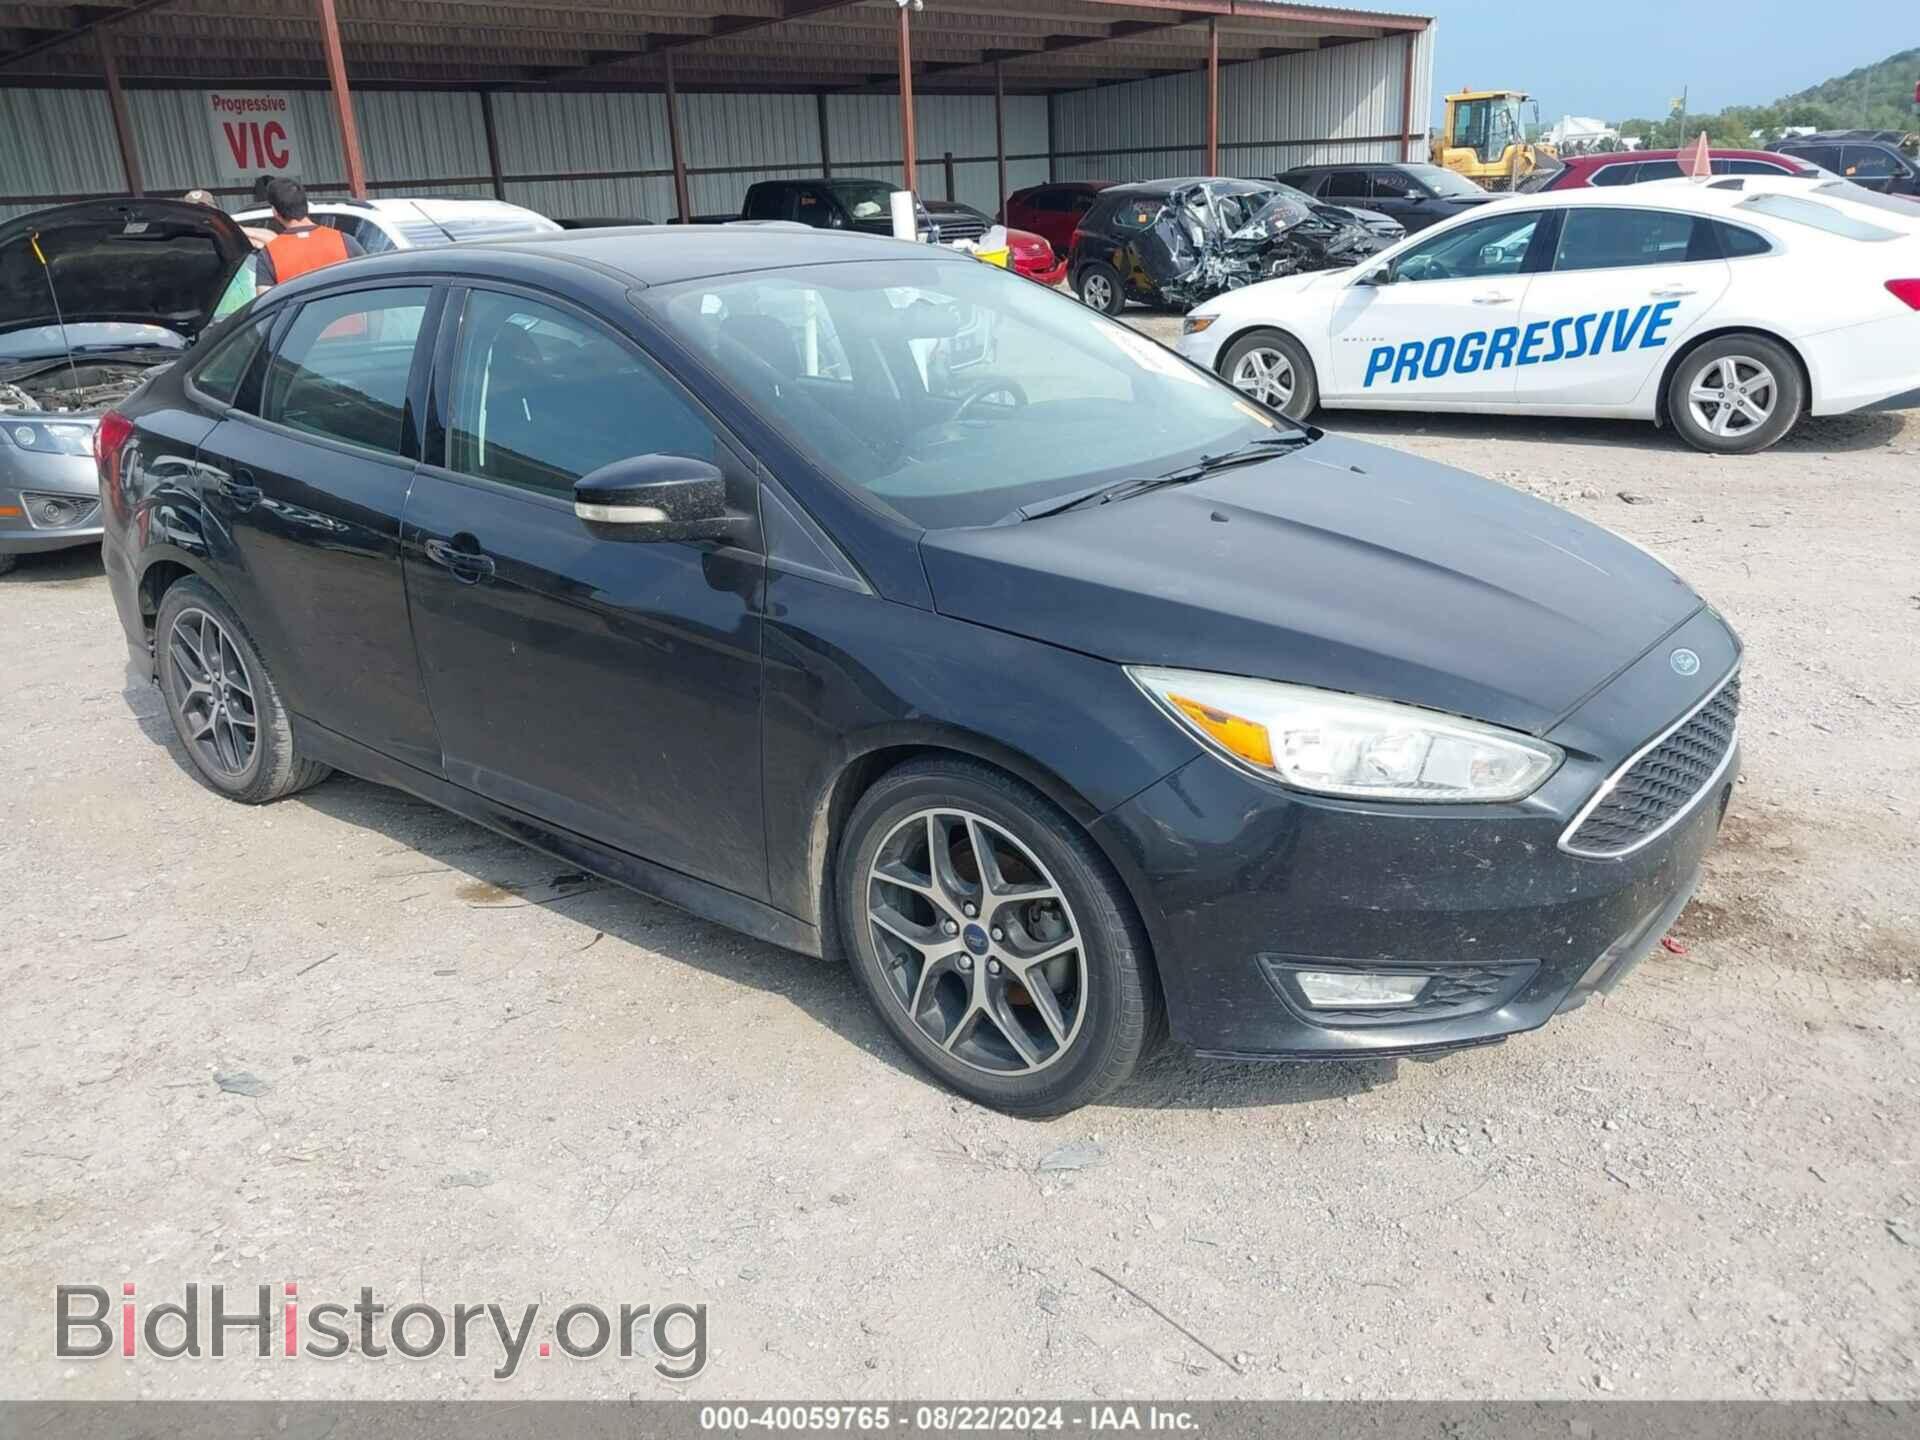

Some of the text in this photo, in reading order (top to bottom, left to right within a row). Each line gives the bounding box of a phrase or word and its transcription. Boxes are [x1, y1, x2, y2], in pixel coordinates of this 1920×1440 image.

[211, 94, 287, 115] Progressive
[222, 121, 289, 169] VIC
[1363, 300, 1681, 388] PROGRESSIVE
